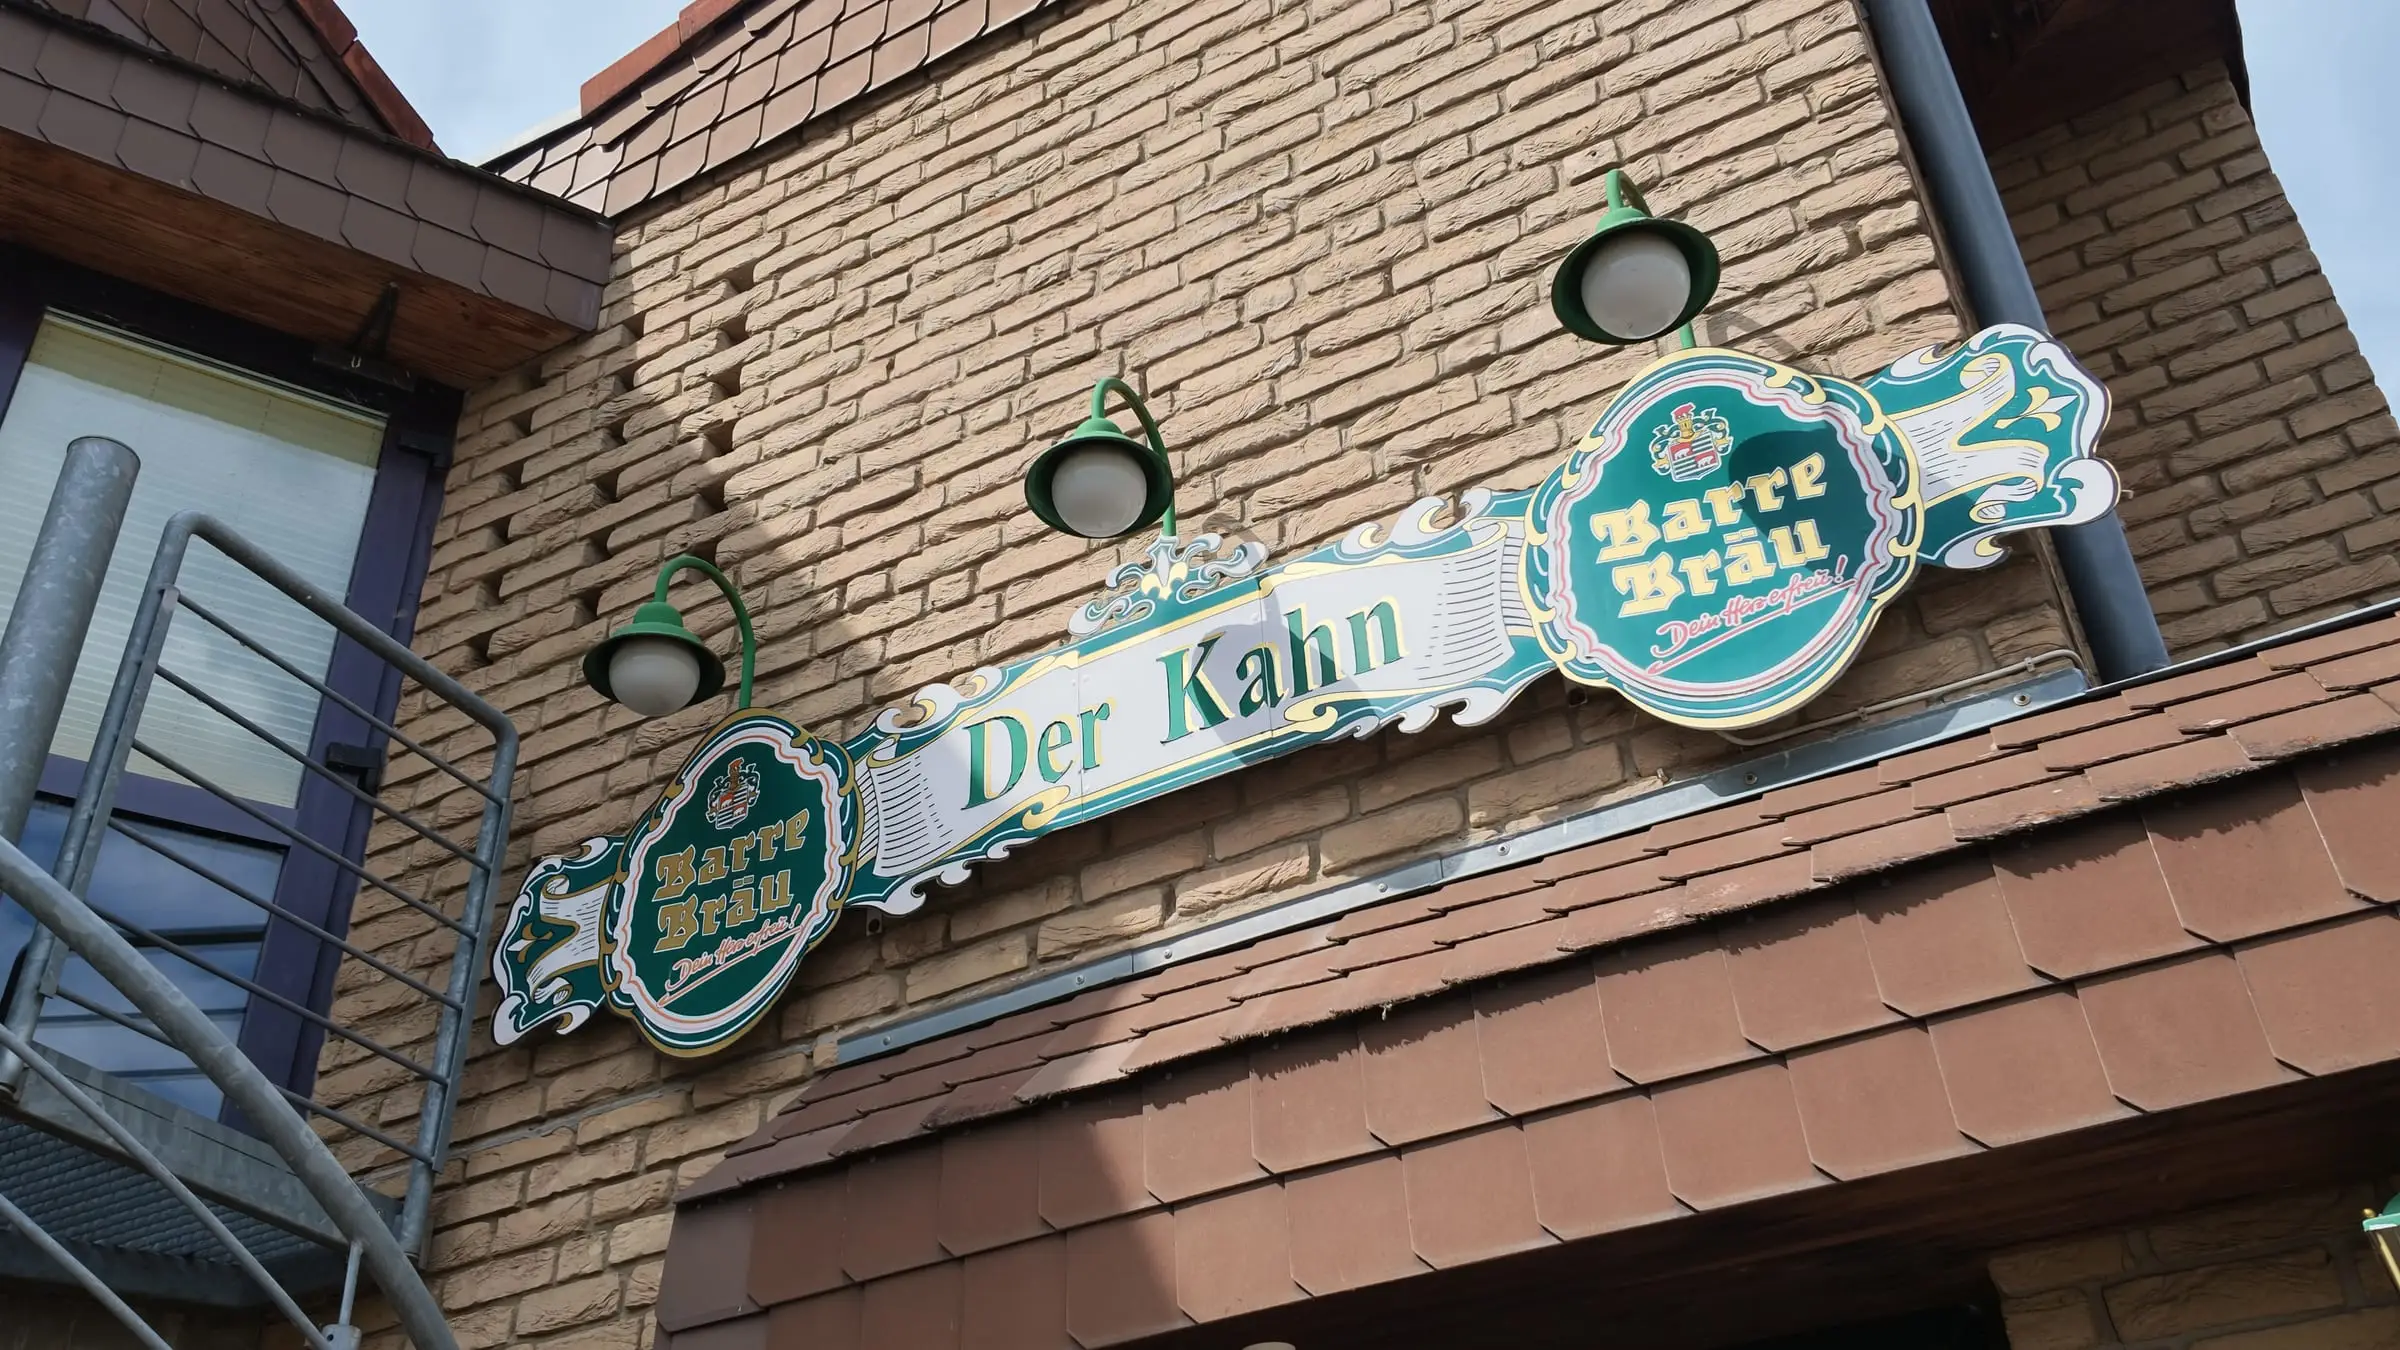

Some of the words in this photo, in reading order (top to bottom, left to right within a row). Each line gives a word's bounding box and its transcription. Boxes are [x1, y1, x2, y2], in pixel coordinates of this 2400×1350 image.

[1590, 453, 1827, 564] Barre
[1612, 519, 1831, 618] Bräu
[1651, 613, 1720, 657] Dein
[961, 696, 1114, 810] Der
[1157, 595, 1410, 745] Kahn
[652, 809, 810, 902] Barre
[653, 870, 794, 953] Bräu
[665, 952, 713, 991] Dein
